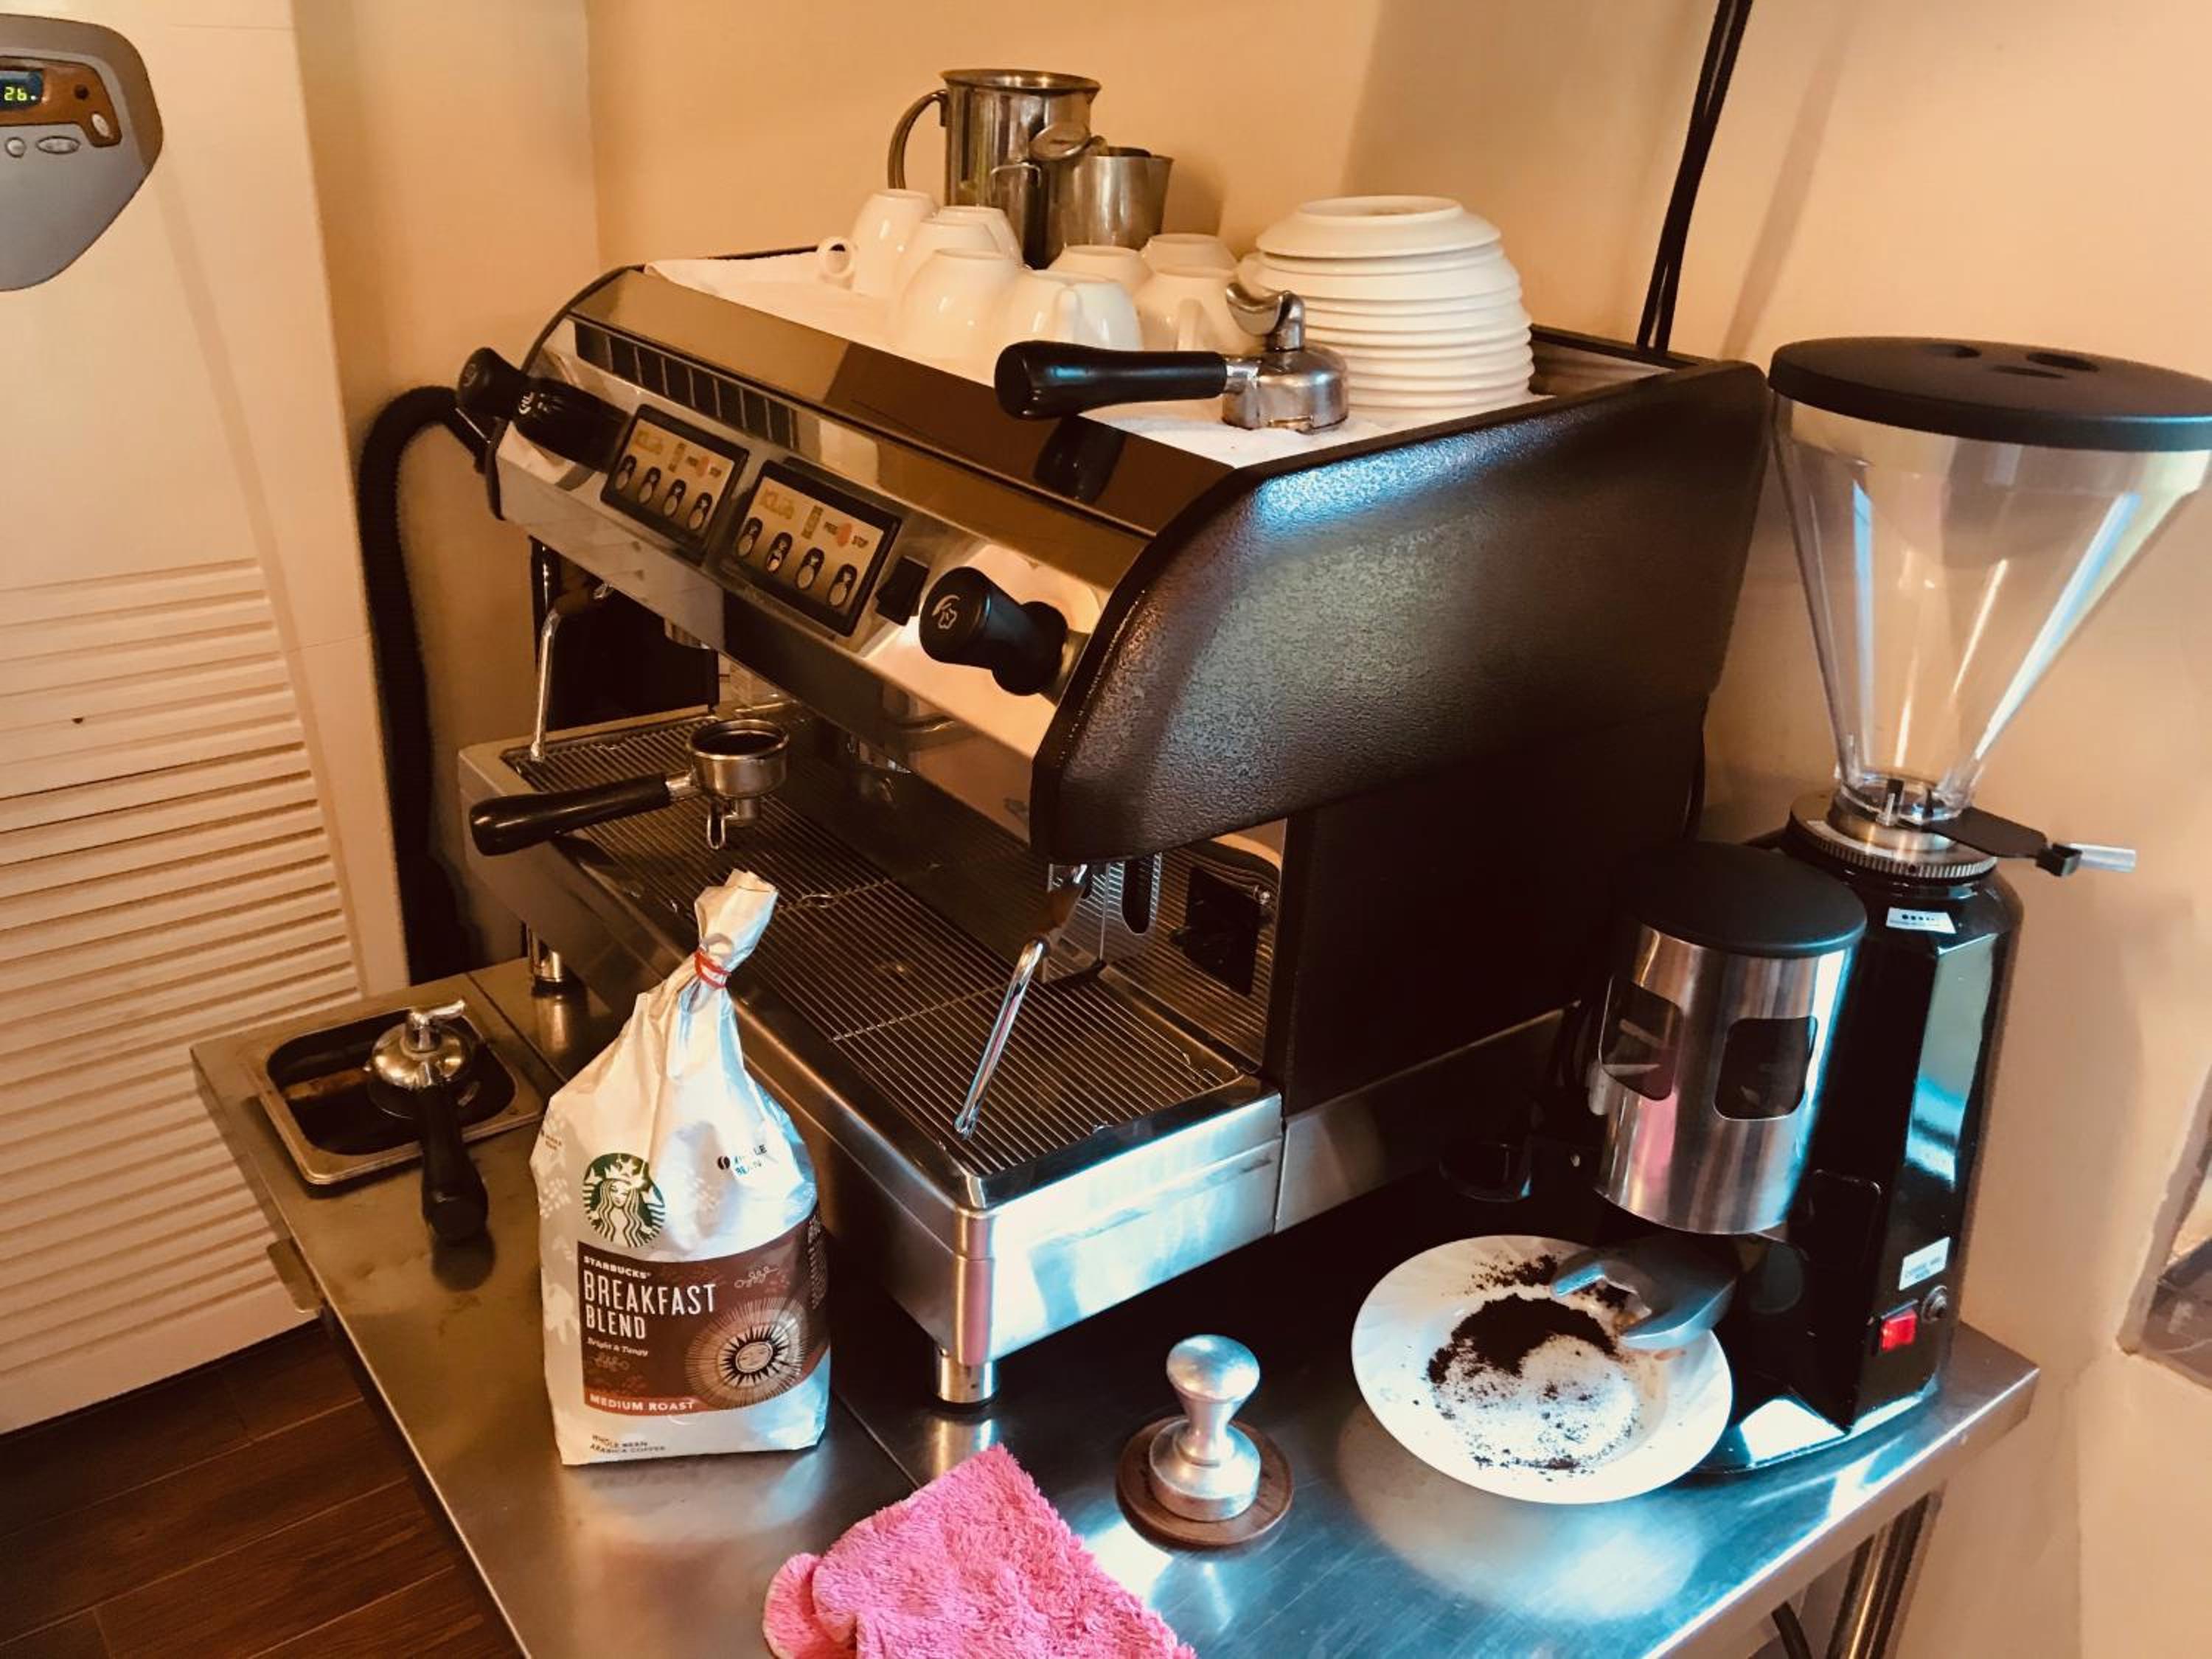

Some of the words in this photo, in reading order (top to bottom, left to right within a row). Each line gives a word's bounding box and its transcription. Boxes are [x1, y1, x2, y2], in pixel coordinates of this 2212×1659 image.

[583, 1270, 716, 1316] BREAKFAST
[585, 1304, 646, 1340] BLEND
[590, 1394, 644, 1411] MEDIUM
[648, 1401, 694, 1411] ROAST
